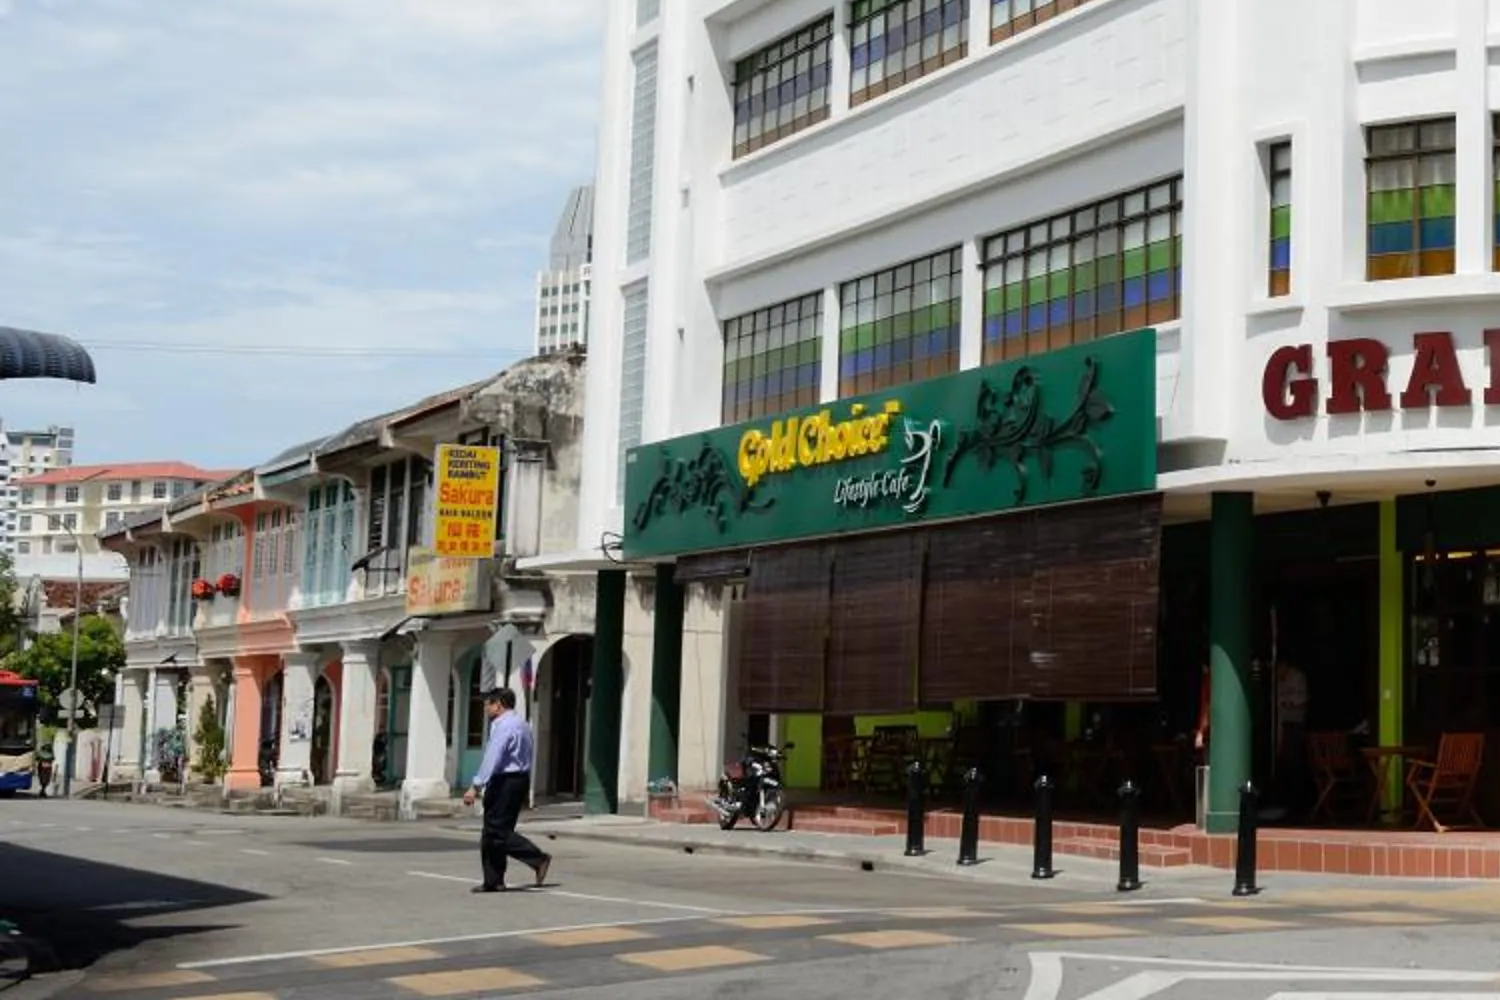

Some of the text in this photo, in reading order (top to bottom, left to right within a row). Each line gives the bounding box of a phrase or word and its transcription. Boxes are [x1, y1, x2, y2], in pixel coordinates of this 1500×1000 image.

[738, 402, 889, 486] Gold Choice
[440, 482, 494, 505] Sakura
[833, 467, 911, 508] Lifestyle Cafe
